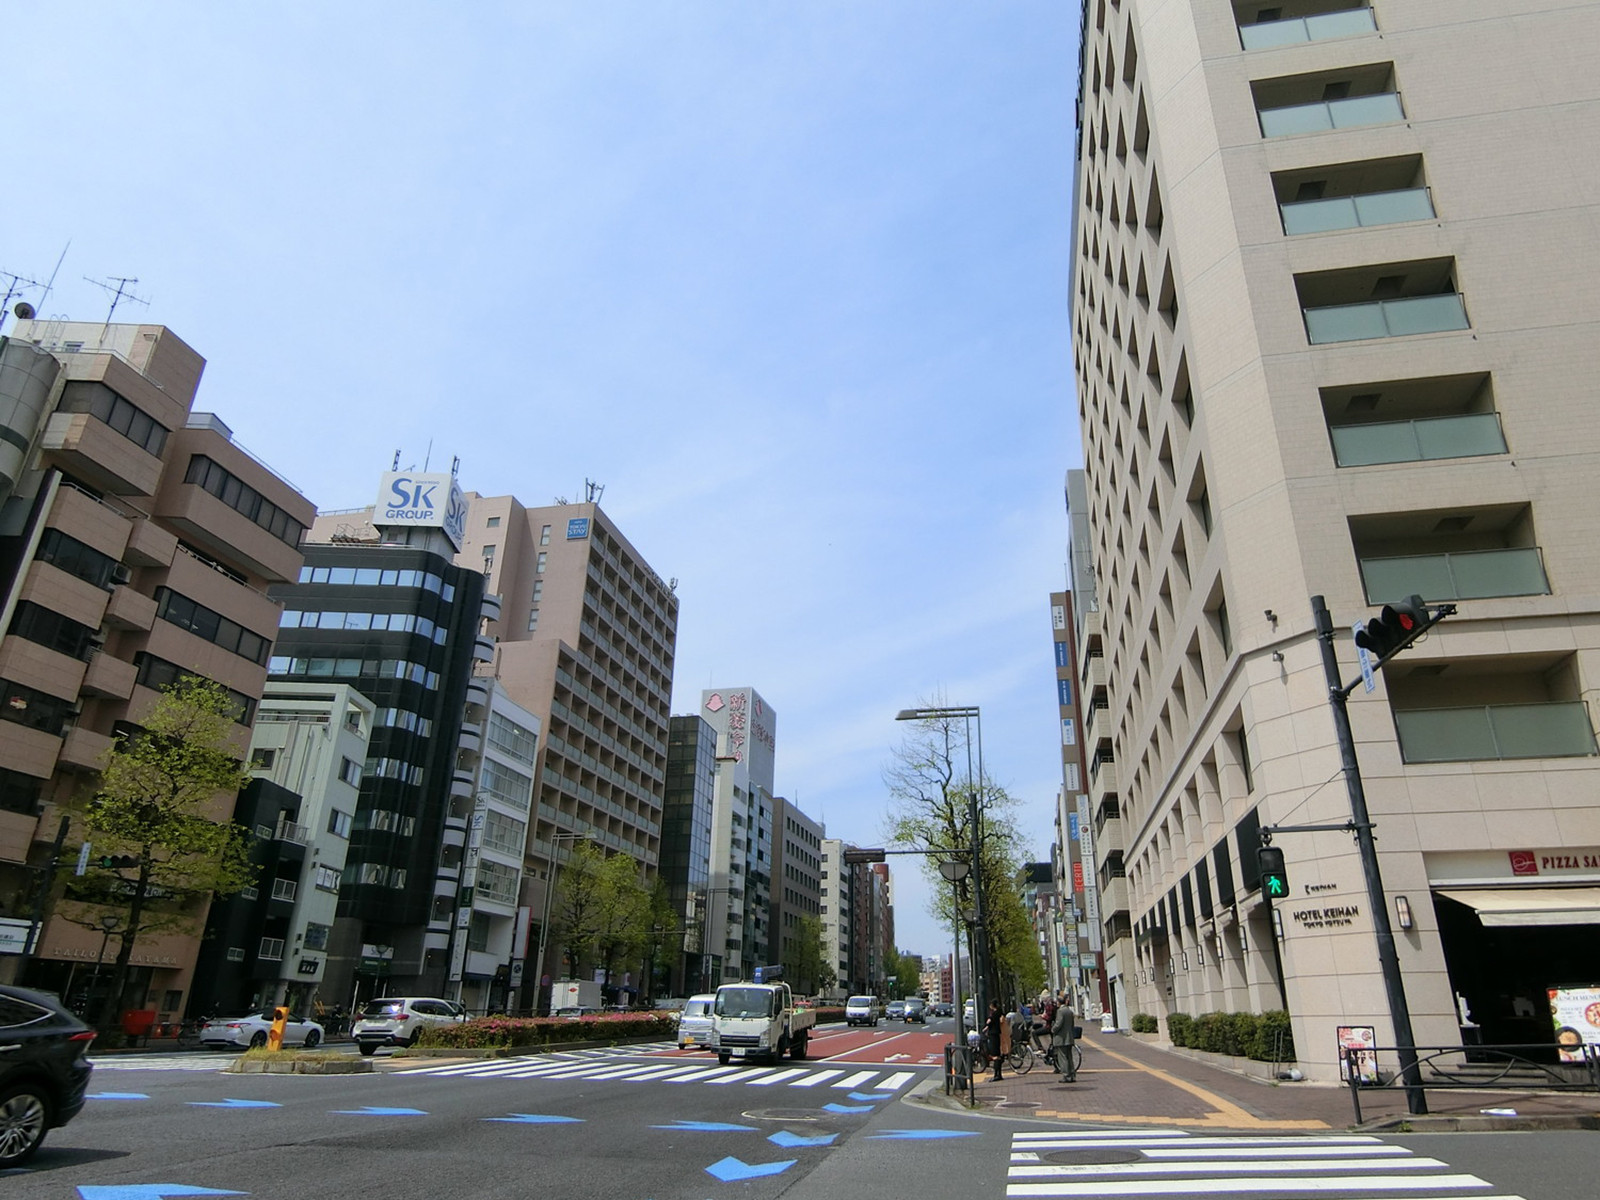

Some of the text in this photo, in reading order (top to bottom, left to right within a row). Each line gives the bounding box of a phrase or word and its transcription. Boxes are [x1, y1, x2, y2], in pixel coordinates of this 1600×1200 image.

[387, 478, 437, 508] SK
[1542, 855, 1600, 869] PIZZA SA
[1293, 905, 1359, 922] HOTEL KEIHAN
[1303, 921, 1323, 929] TOKYO
